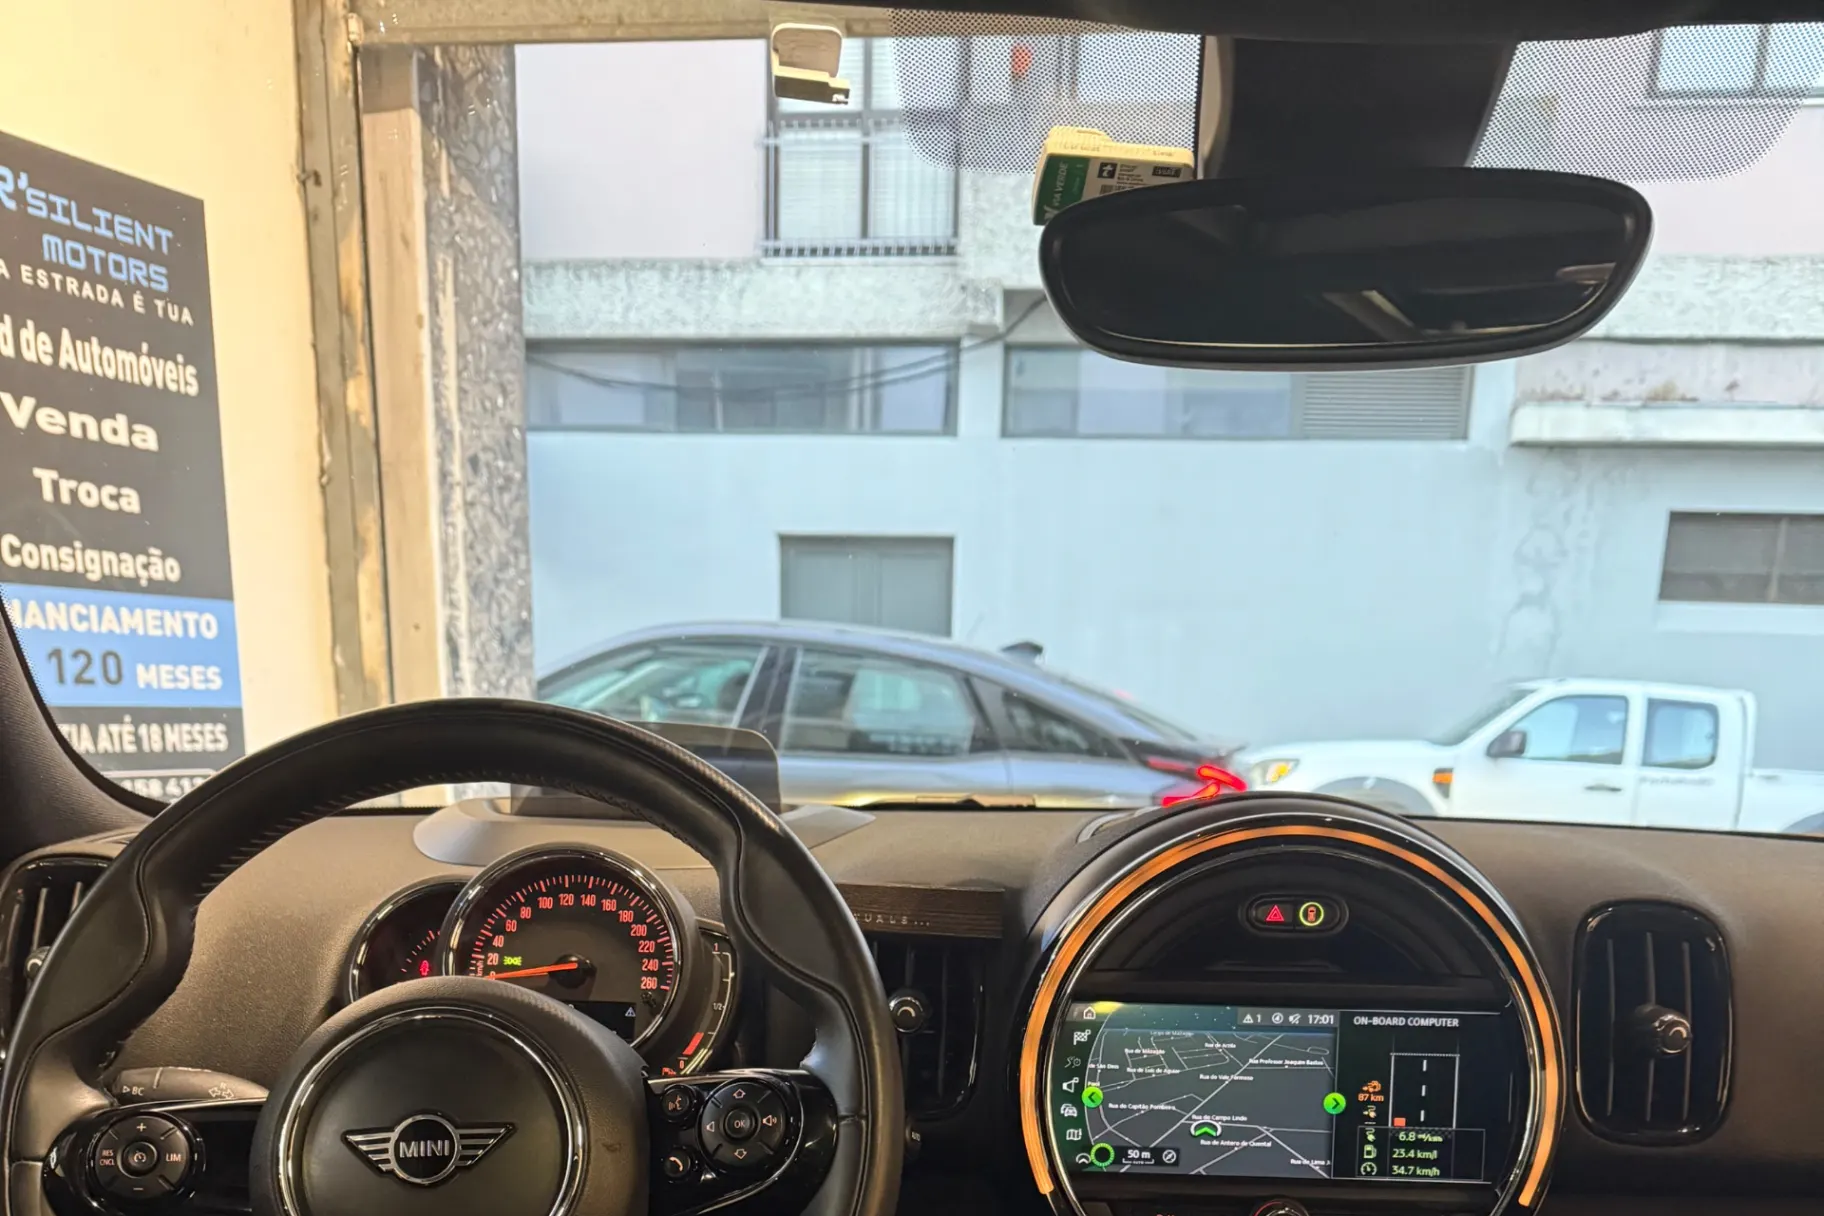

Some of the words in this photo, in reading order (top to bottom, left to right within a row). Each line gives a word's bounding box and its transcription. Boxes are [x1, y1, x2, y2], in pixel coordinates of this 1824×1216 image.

[1055, 162, 1068, 191] VERDE
[42, 233, 169, 292] MOTORS
[21, 264, 124, 309] ESTRADA
[133, 290, 146, 313] É
[154, 298, 194, 326] TUA
[20, 319, 54, 366] de
[59, 327, 199, 397] Automóveis
[0, 391, 159, 452] Venda
[33, 466, 142, 514] Troca
[1, 533, 181, 587] Consignação
[47, 647, 123, 686] 120
[136, 662, 223, 691] MESES
[97, 714, 138, 754] ATÉ
[163, 723, 229, 753] MESES
[537, 897, 553, 909] 100
[559, 894, 574, 906] 120
[580, 894, 596, 907] 140
[601, 899, 617, 912] 160
[520, 907, 532, 919] 80
[618, 910, 634, 923] 180
[505, 920, 517, 932] 60
[630, 923, 647, 936] 200
[492, 935, 504, 948] 40
[638, 940, 655, 953] 220
[487, 952, 499, 966] 20
[642, 959, 659, 972] 240
[640, 976, 657, 989] 260
[713, 1002, 722, 1010] 1/2
[1256, 1014, 1262, 1023] 1
[1308, 1014, 1334, 1024] 17:01
[1353, 1016, 1405, 1027] ON-BOARD
[1407, 1016, 1459, 1027] COMPUTER
[132, 1086, 145, 1095] BC
[1371, 1094, 1384, 1102] km
[734, 1119, 746, 1129] OK
[1399, 1131, 1416, 1141] 6.8
[399, 1139, 450, 1158] MINI
[1127, 1149, 1140, 1158] 50
[166, 1153, 182, 1162] LIM
[1391, 1165, 1415, 1175] 34.7
[1416, 1167, 1440, 1176] km/h
